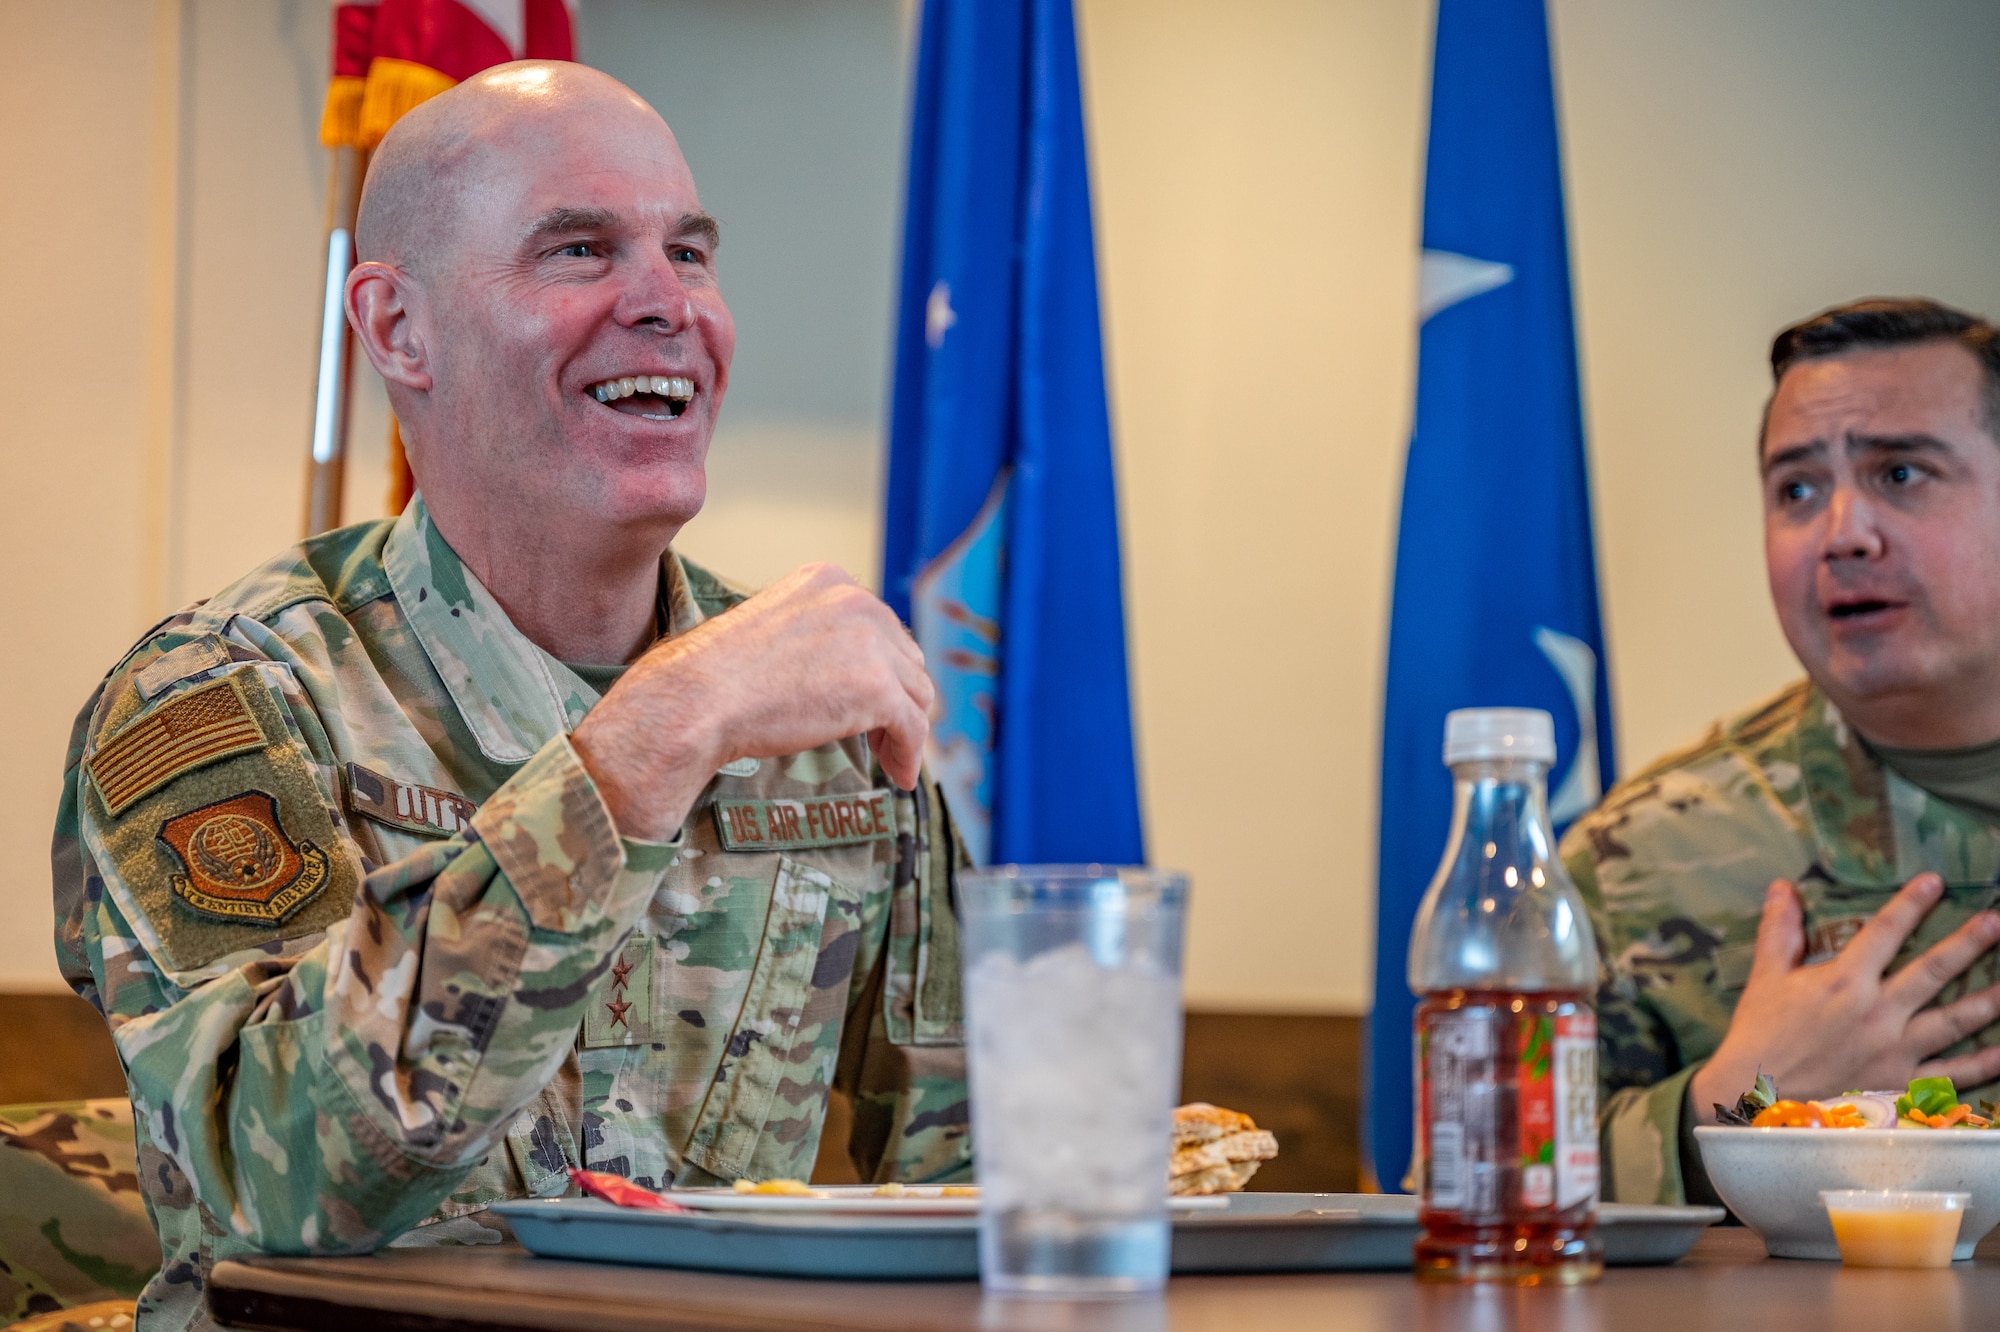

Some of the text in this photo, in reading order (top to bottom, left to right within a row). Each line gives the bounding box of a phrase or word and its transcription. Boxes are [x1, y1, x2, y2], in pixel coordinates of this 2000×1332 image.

[727, 797, 889, 842] US AIR FORCE
[184, 861, 322, 915] TWENTIETH AIR FORCE
